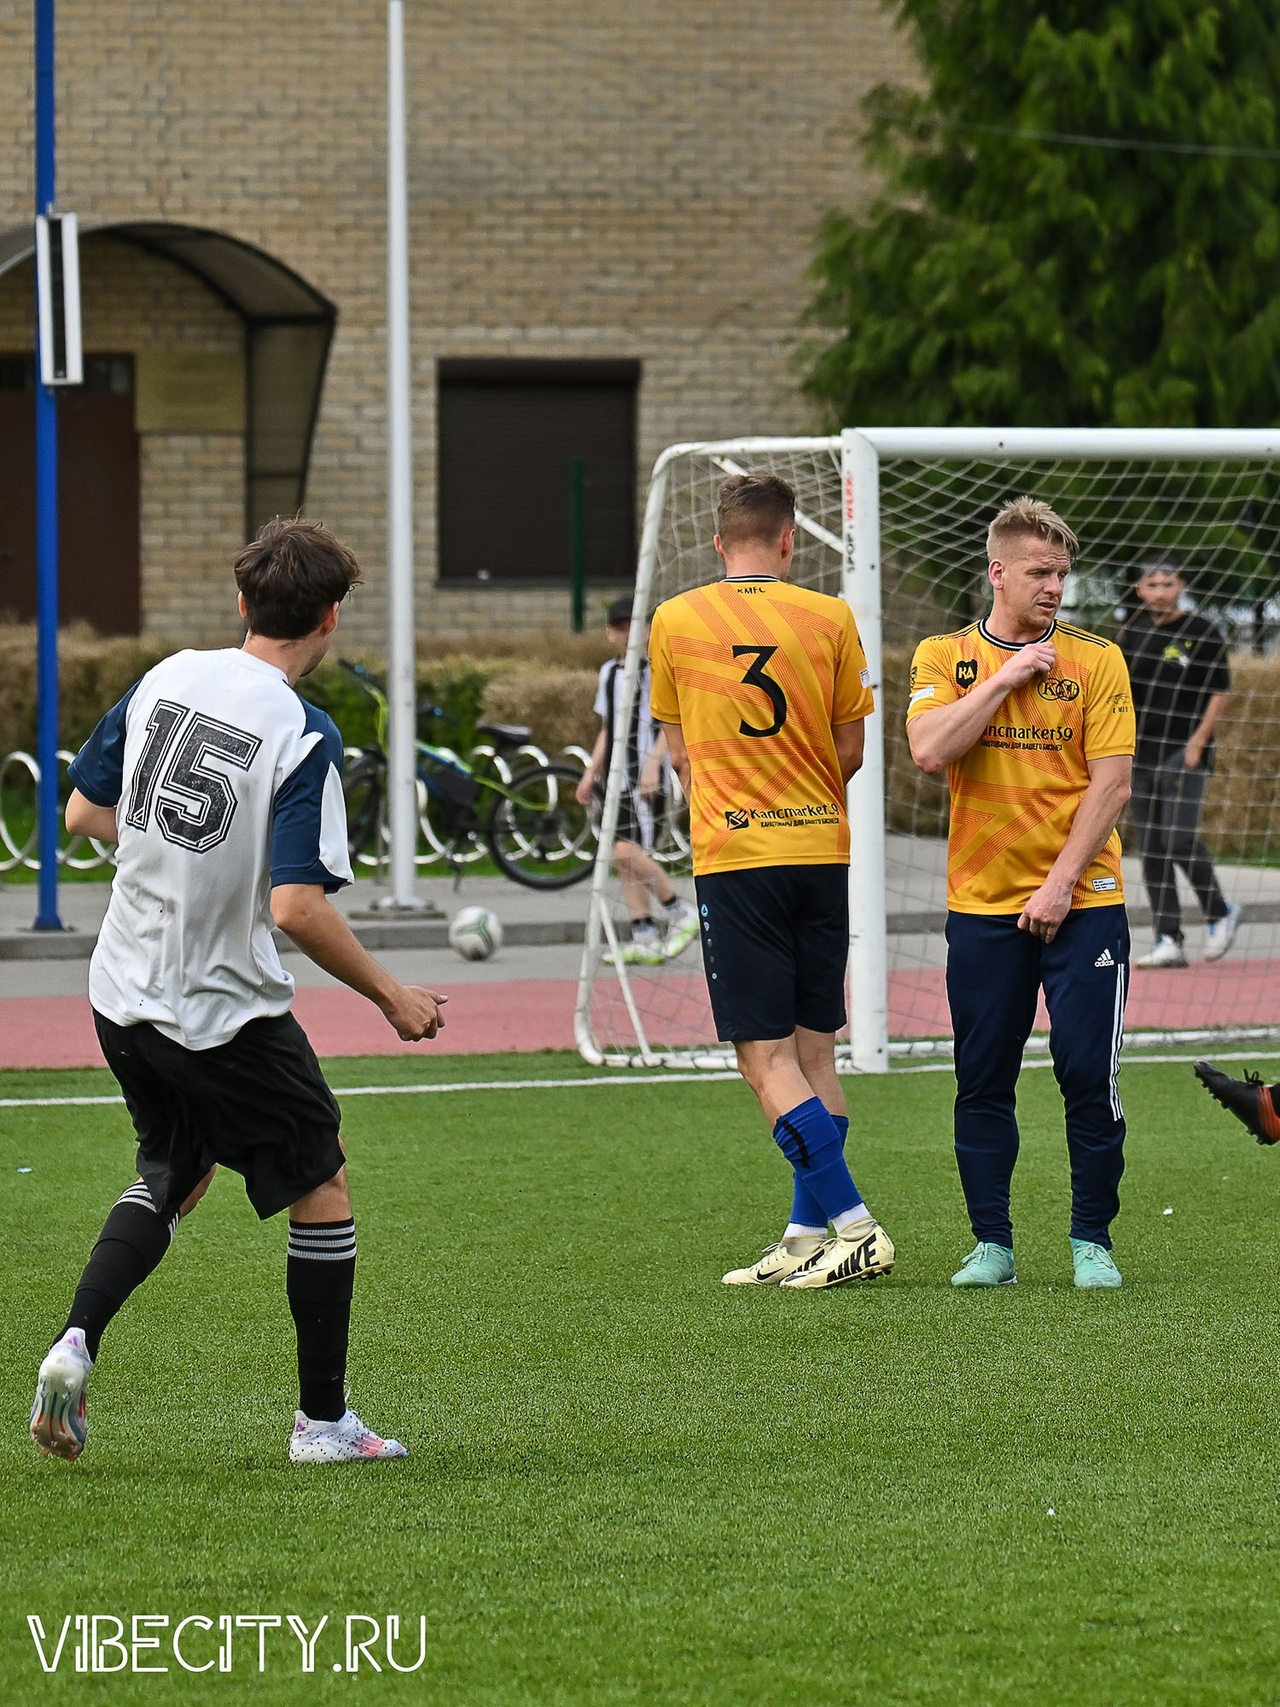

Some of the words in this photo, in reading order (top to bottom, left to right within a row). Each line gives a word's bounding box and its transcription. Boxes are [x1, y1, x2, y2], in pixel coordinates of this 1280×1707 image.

[732, 645, 787, 738] 3
[126, 699, 263, 855] 15
[826, 1232, 880, 1284] NIKE
